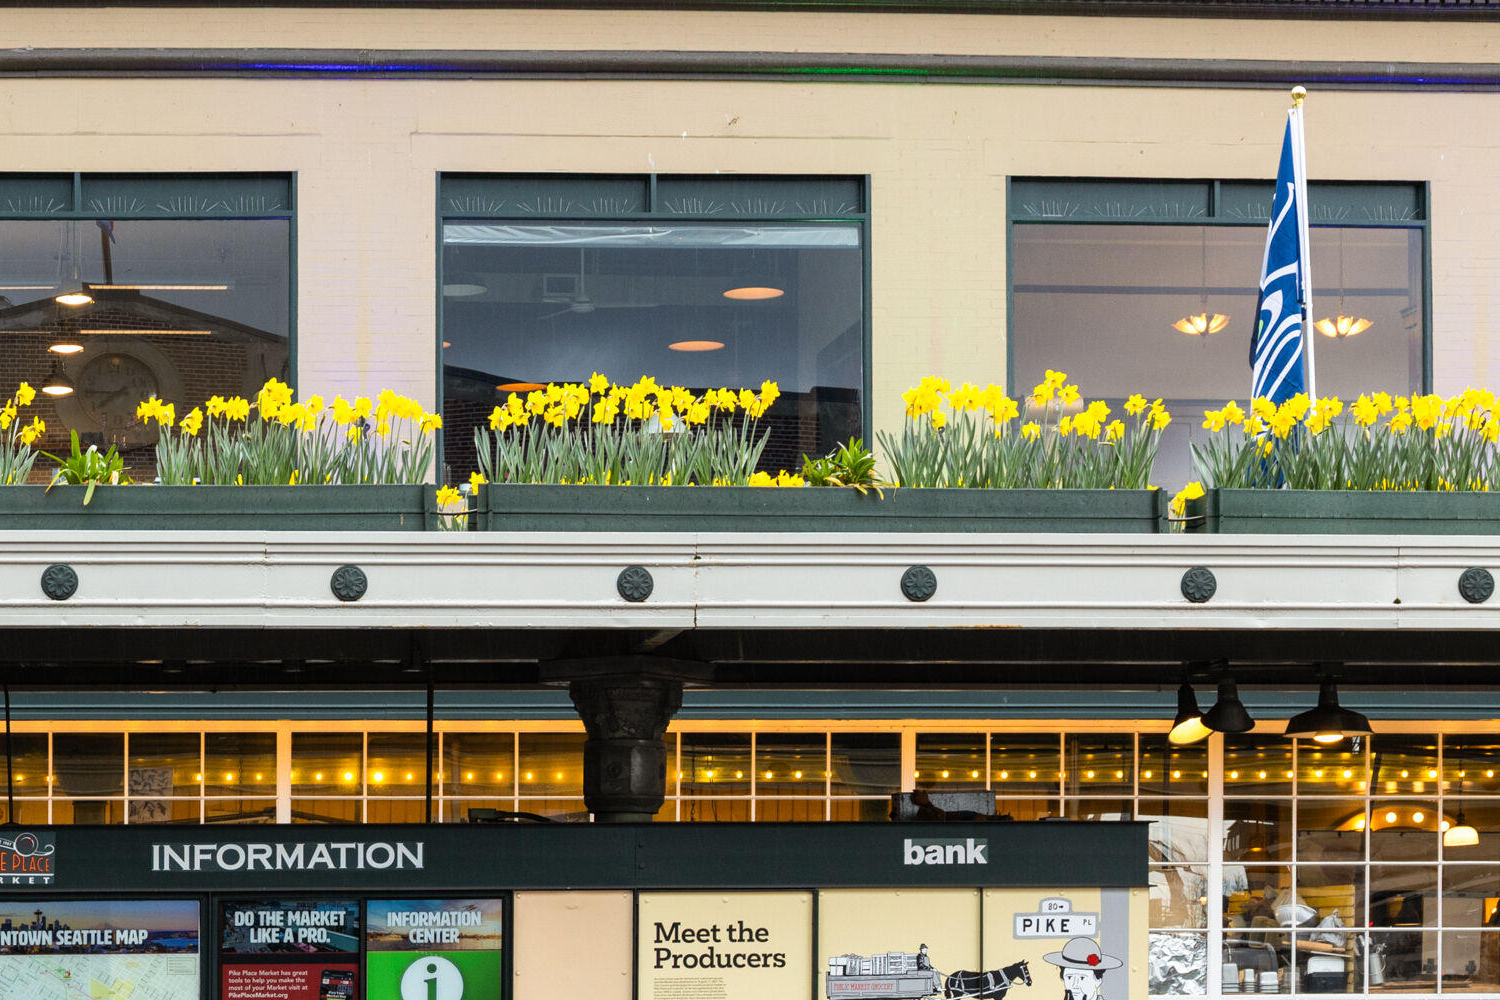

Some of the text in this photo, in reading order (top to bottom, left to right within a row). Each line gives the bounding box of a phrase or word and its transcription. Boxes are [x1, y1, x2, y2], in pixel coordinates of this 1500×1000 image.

[152, 842, 424, 871] INFORMATION
[904, 838, 987, 865] bank
[12, 853, 50, 872] PLACE
[1048, 903, 1058, 911] 80
[234, 911, 346, 927] DO THE MARKET
[387, 911, 481, 927] INFORMATION
[1022, 918, 1070, 933] PIKE
[55, 929, 113, 946] SEATTLE
[115, 929, 149, 945] MAP
[250, 928, 331, 943] LIKE A PRO.
[409, 928, 460, 944] CENTER
[653, 921, 769, 944] Meet the
[653, 947, 786, 970] Producers
[850, 983, 870, 991] MARKET
[871, 983, 894, 991] GROCERY
